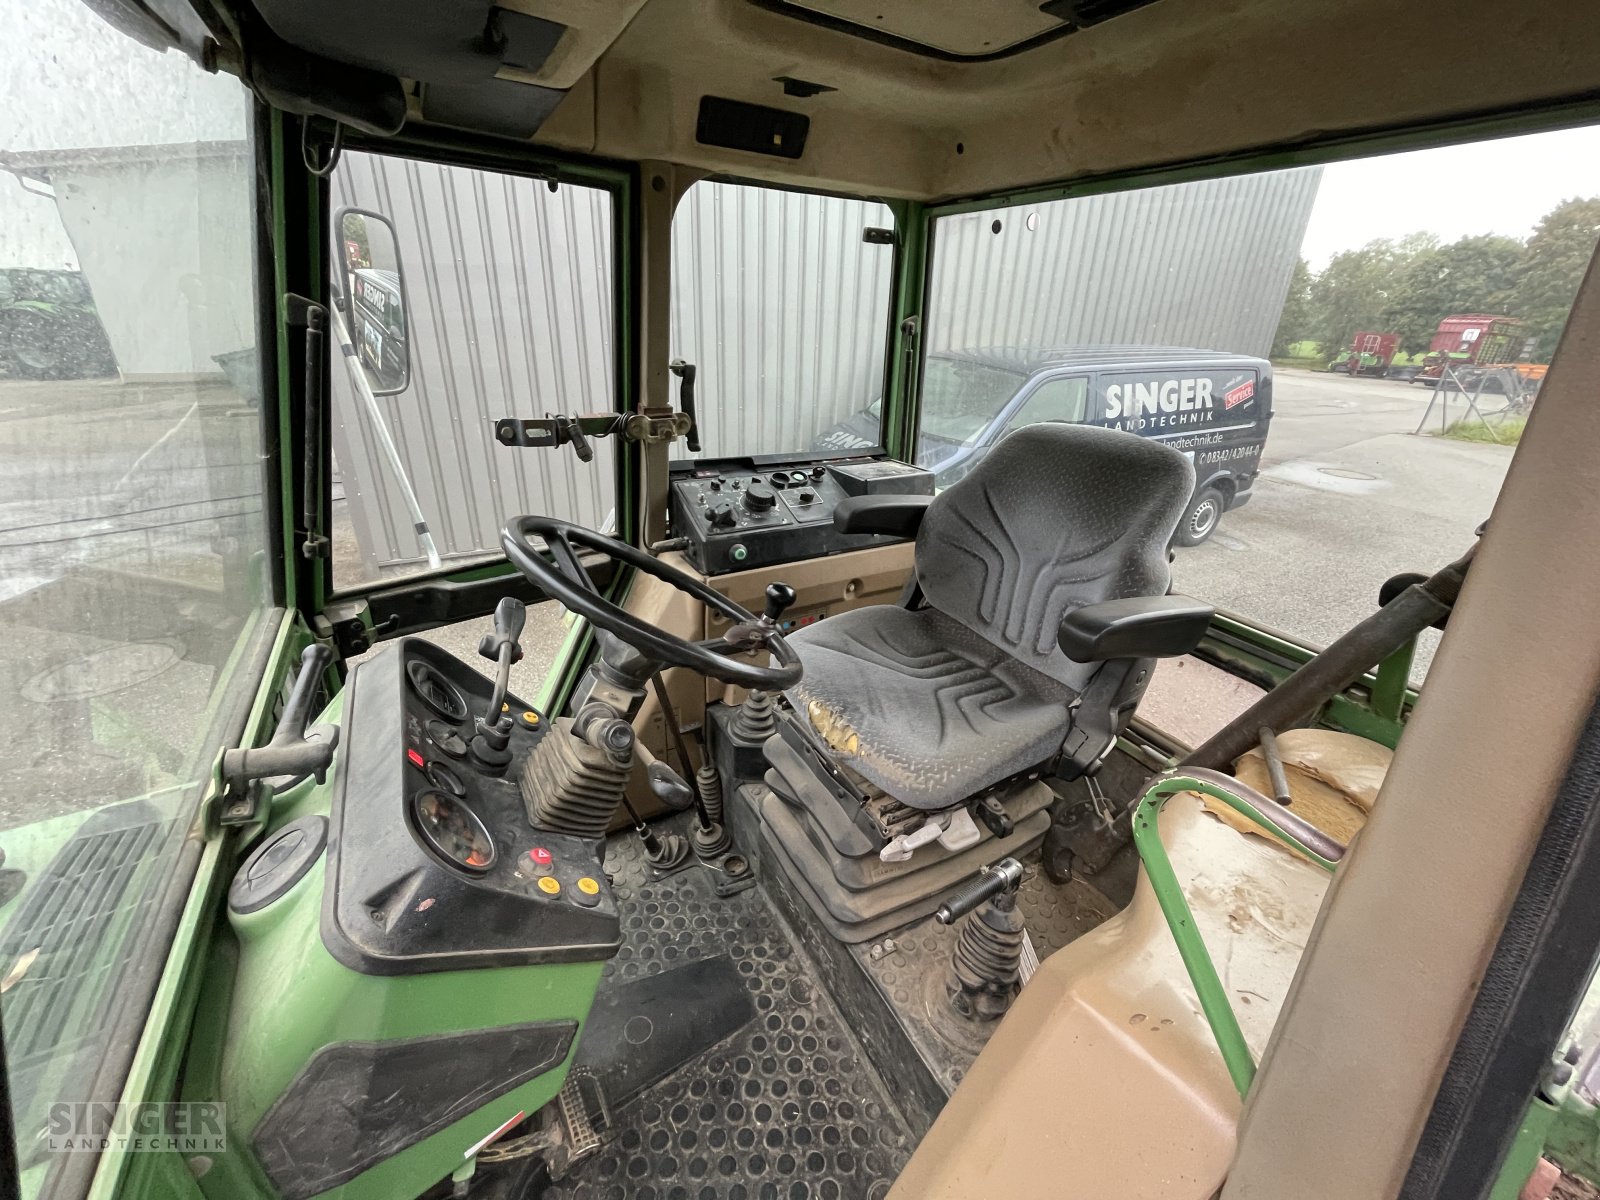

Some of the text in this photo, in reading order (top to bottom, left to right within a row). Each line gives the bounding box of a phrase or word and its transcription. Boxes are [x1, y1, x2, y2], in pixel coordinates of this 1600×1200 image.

[1105, 378, 1213, 419] SINGER
[1226, 384, 1252, 407] Service
[825, 431, 878, 449] SING
